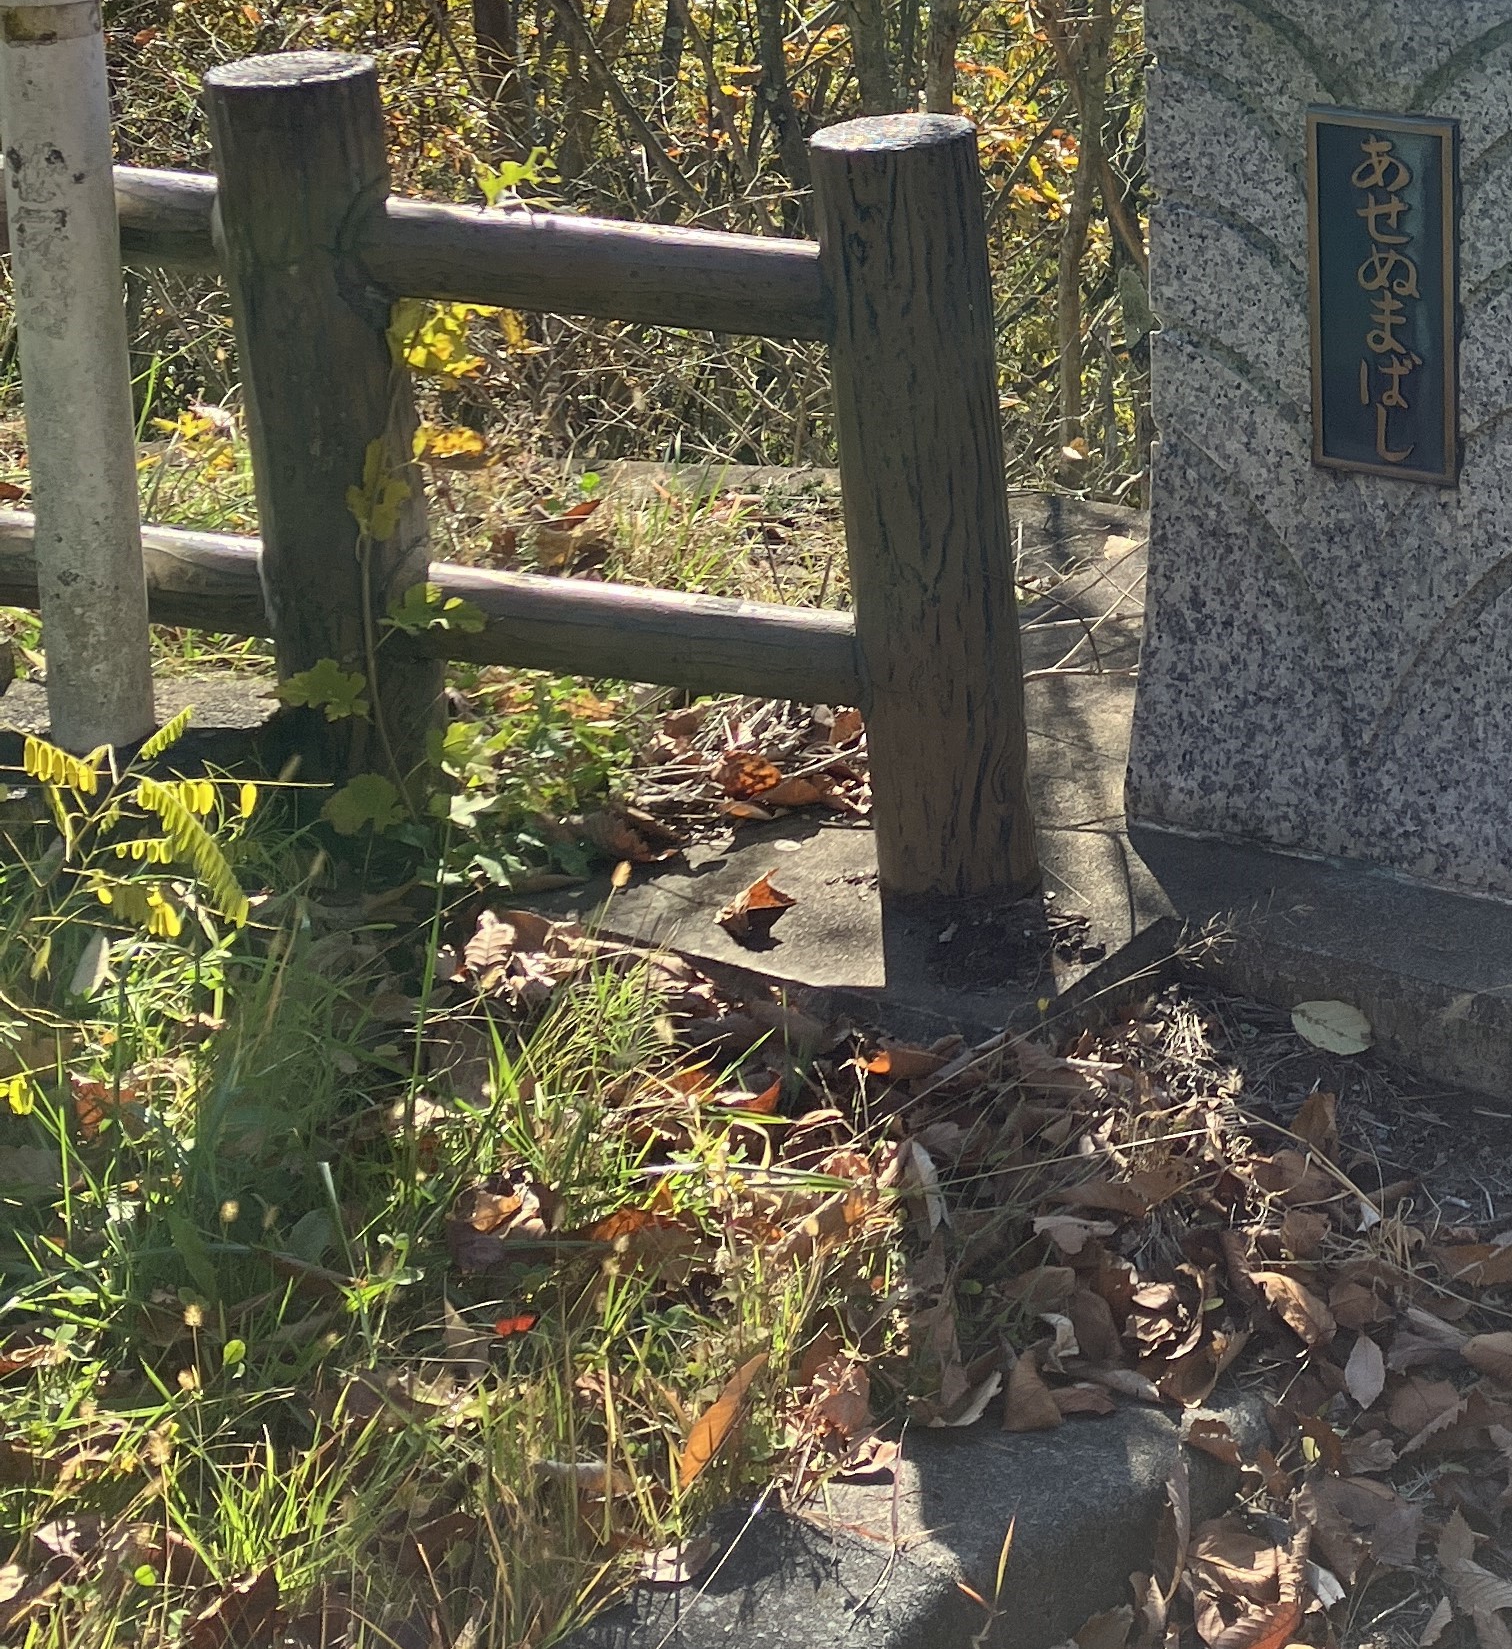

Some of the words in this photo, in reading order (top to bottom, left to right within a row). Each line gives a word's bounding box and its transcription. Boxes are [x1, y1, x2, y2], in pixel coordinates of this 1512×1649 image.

[1351, 134, 1422, 463] あせぬまばし
